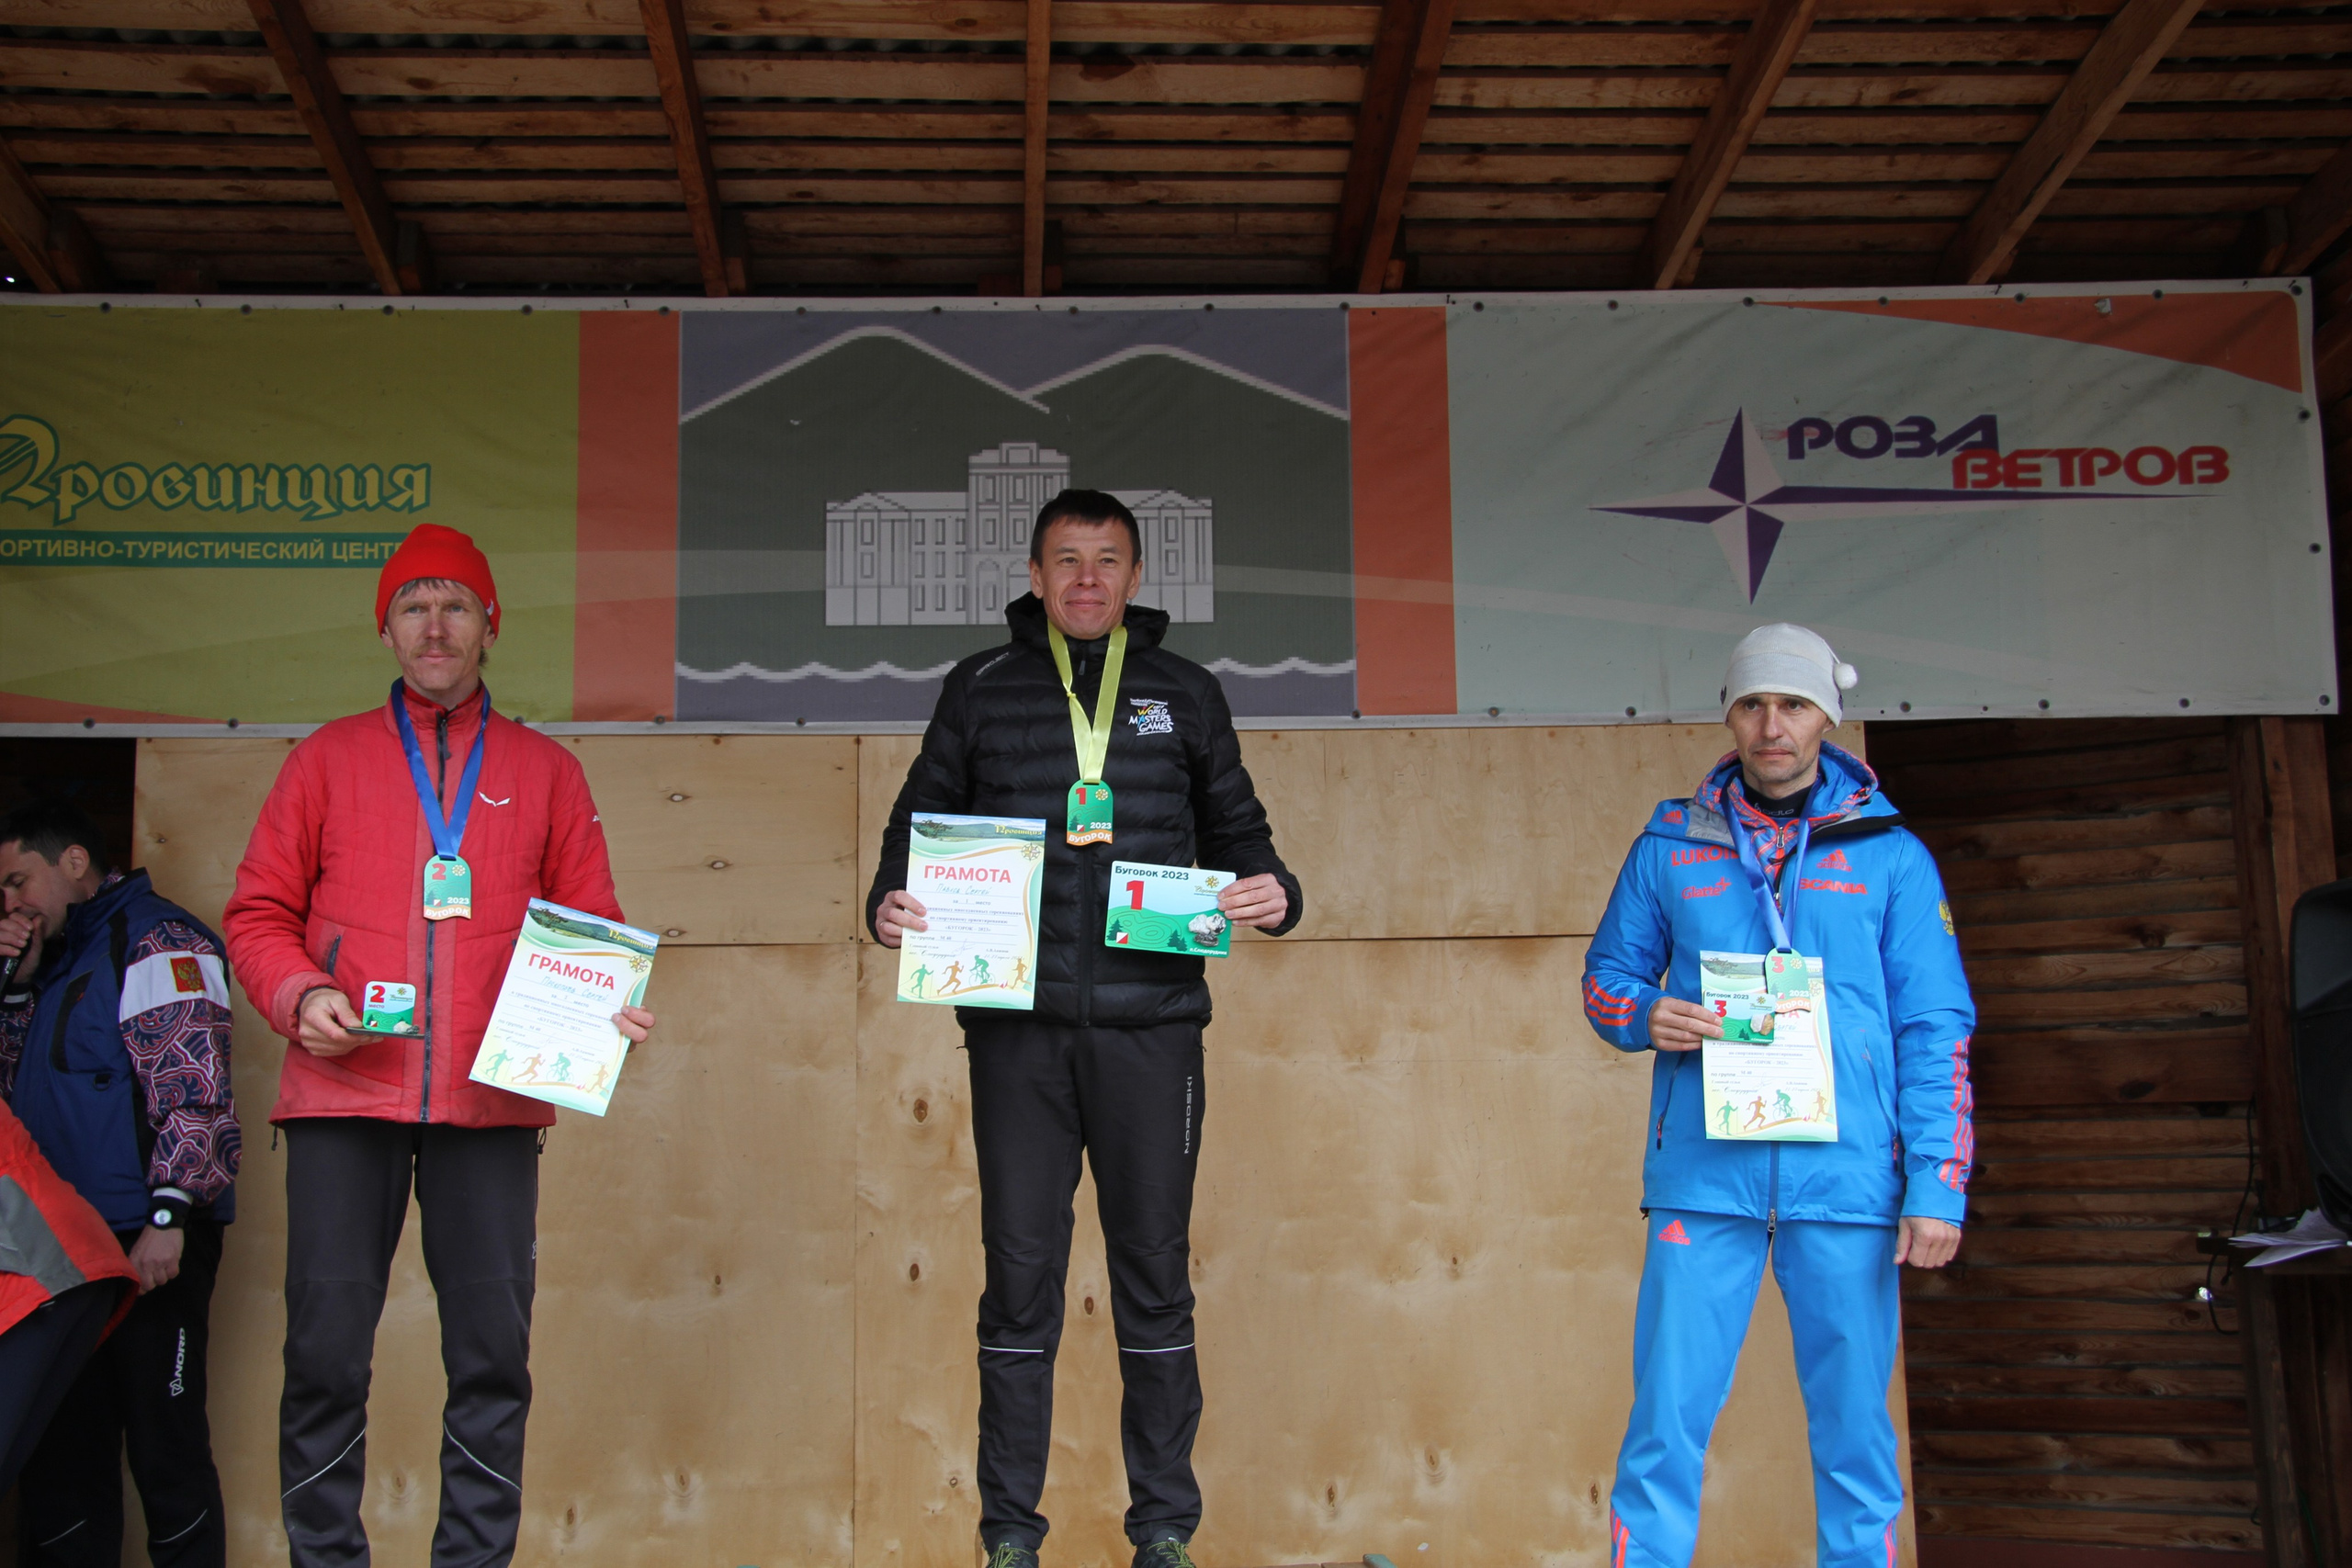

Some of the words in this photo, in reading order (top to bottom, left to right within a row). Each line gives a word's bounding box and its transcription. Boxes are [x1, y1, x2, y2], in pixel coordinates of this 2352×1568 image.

[1787, 413, 2000, 460] РОЗА
[1951, 445, 2230, 490] ВЕТРОВ
[1137, 704, 1168, 716] WORLD
[1128, 715, 1171, 728] MASTERS
[1139, 722, 1174, 733] GAMES
[1076, 787, 1086, 805] 1
[1069, 832, 1112, 842] БУГОРОК
[432, 863, 447, 880] 2
[923, 865, 1012, 884] ГРАМОТА
[1114, 865, 1159, 877] Бугорок
[1161, 870, 1189, 880] 2023
[1125, 880, 1145, 910] 1
[1800, 878, 1868, 895] SCANIA
[425, 907, 469, 917] БУГОРОК
[528, 953, 615, 990] ГРАМОТА
[1771, 956, 1785, 974] 3
[369, 985, 386, 1003] 2
[1713, 999, 1727, 1018] 3
[1775, 999, 1811, 1010] УГОРОК
